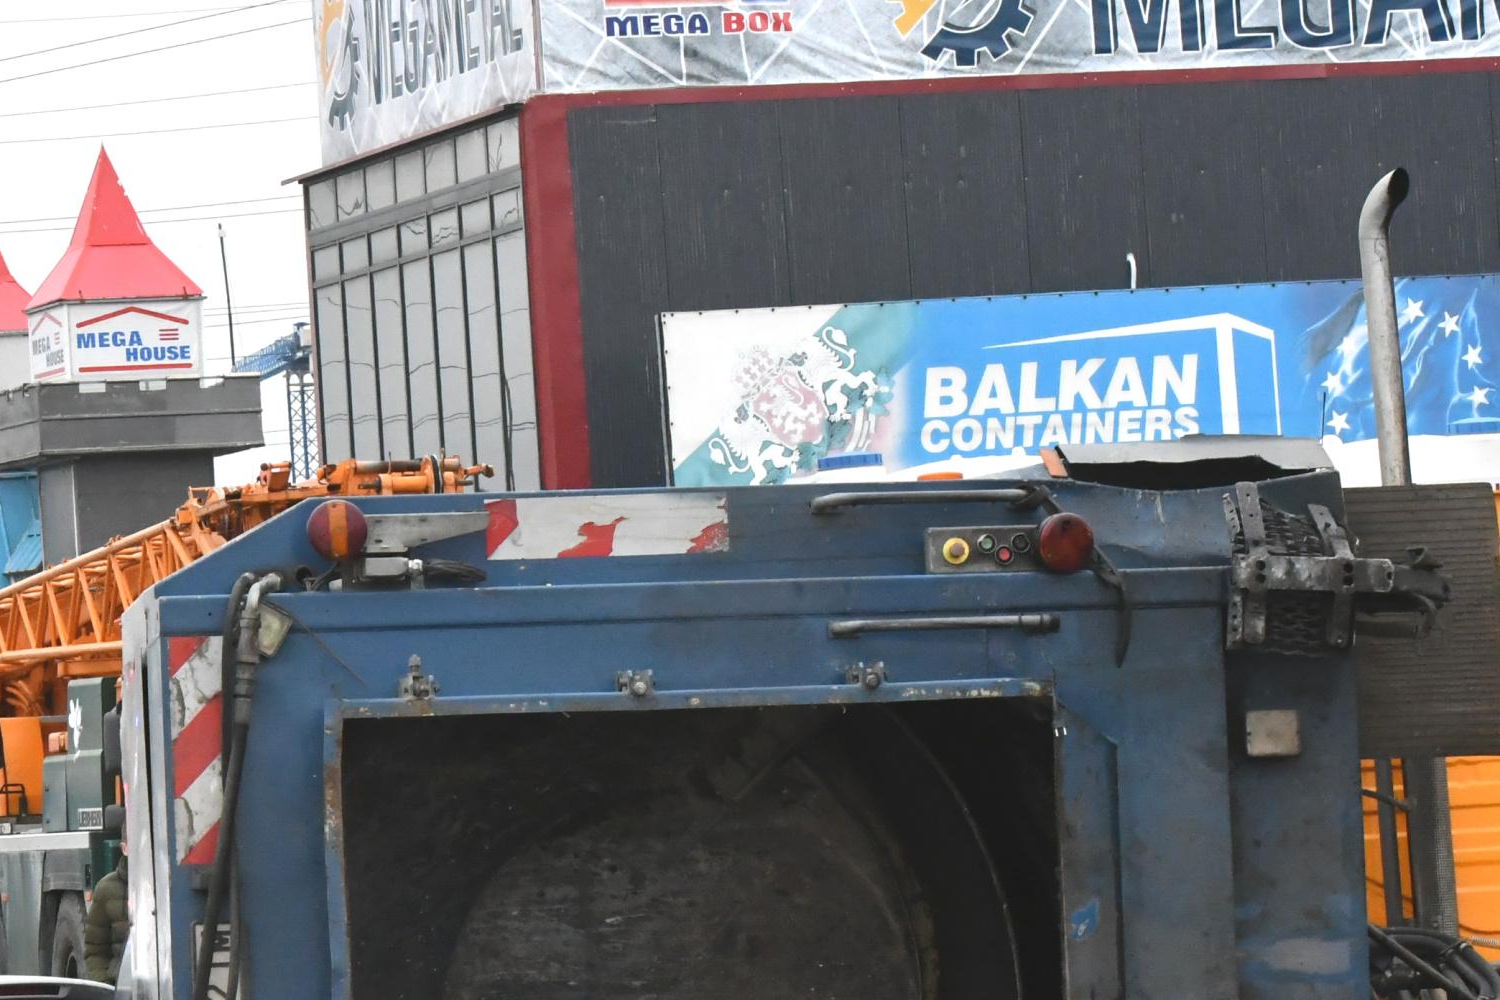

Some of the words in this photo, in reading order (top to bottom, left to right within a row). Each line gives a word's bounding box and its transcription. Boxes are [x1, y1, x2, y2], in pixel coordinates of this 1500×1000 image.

[605, 14, 709, 37] MEGA
[723, 12, 793, 33] BOX
[32, 336, 51, 355] MEGA
[77, 331, 143, 348] MEGA
[46, 349, 65, 367] HOUSE
[126, 345, 191, 361] HOUSE
[923, 354, 1198, 418] BALKAN
[921, 407, 1199, 453] CONTAINERS
